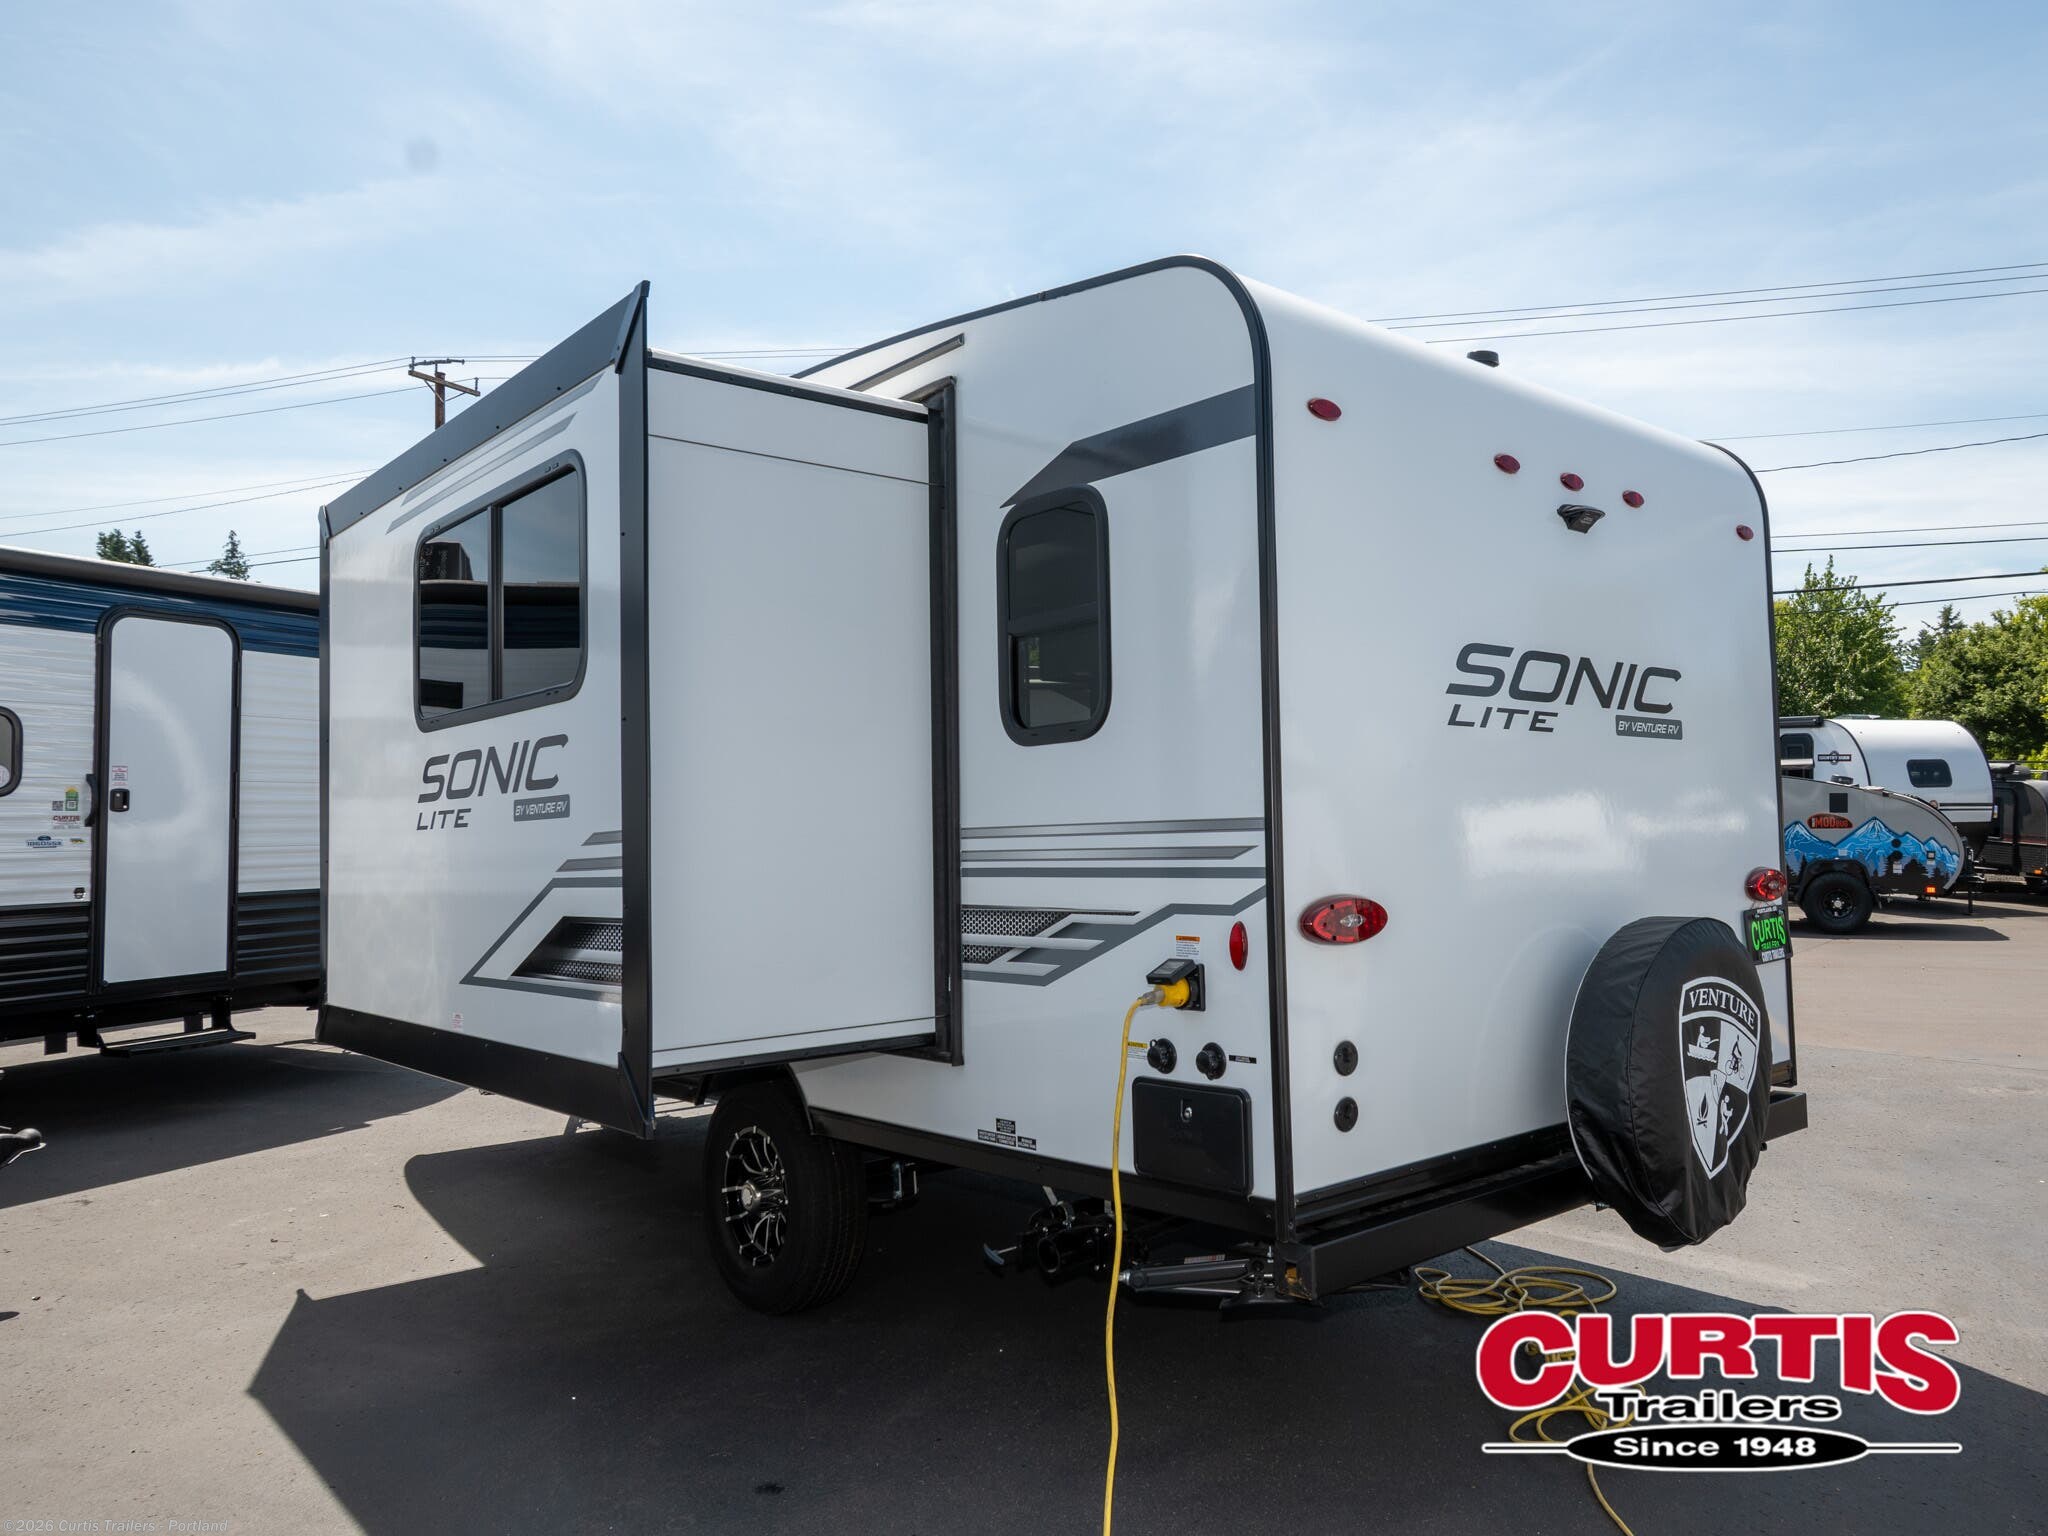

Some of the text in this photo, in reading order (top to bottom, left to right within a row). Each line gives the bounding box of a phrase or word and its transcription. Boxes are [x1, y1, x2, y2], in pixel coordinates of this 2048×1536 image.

[1445, 642, 1682, 715] SONIC
[1447, 703, 1559, 733] LITE
[1618, 720, 1680, 735] BY VENTURE RV
[417, 733, 569, 804] SONIC
[416, 808, 472, 831] LITE
[515, 800, 568, 816] BY VENTURE RV
[1751, 916, 1787, 951] CURTIS
[1689, 987, 1755, 1030] VENTURE
